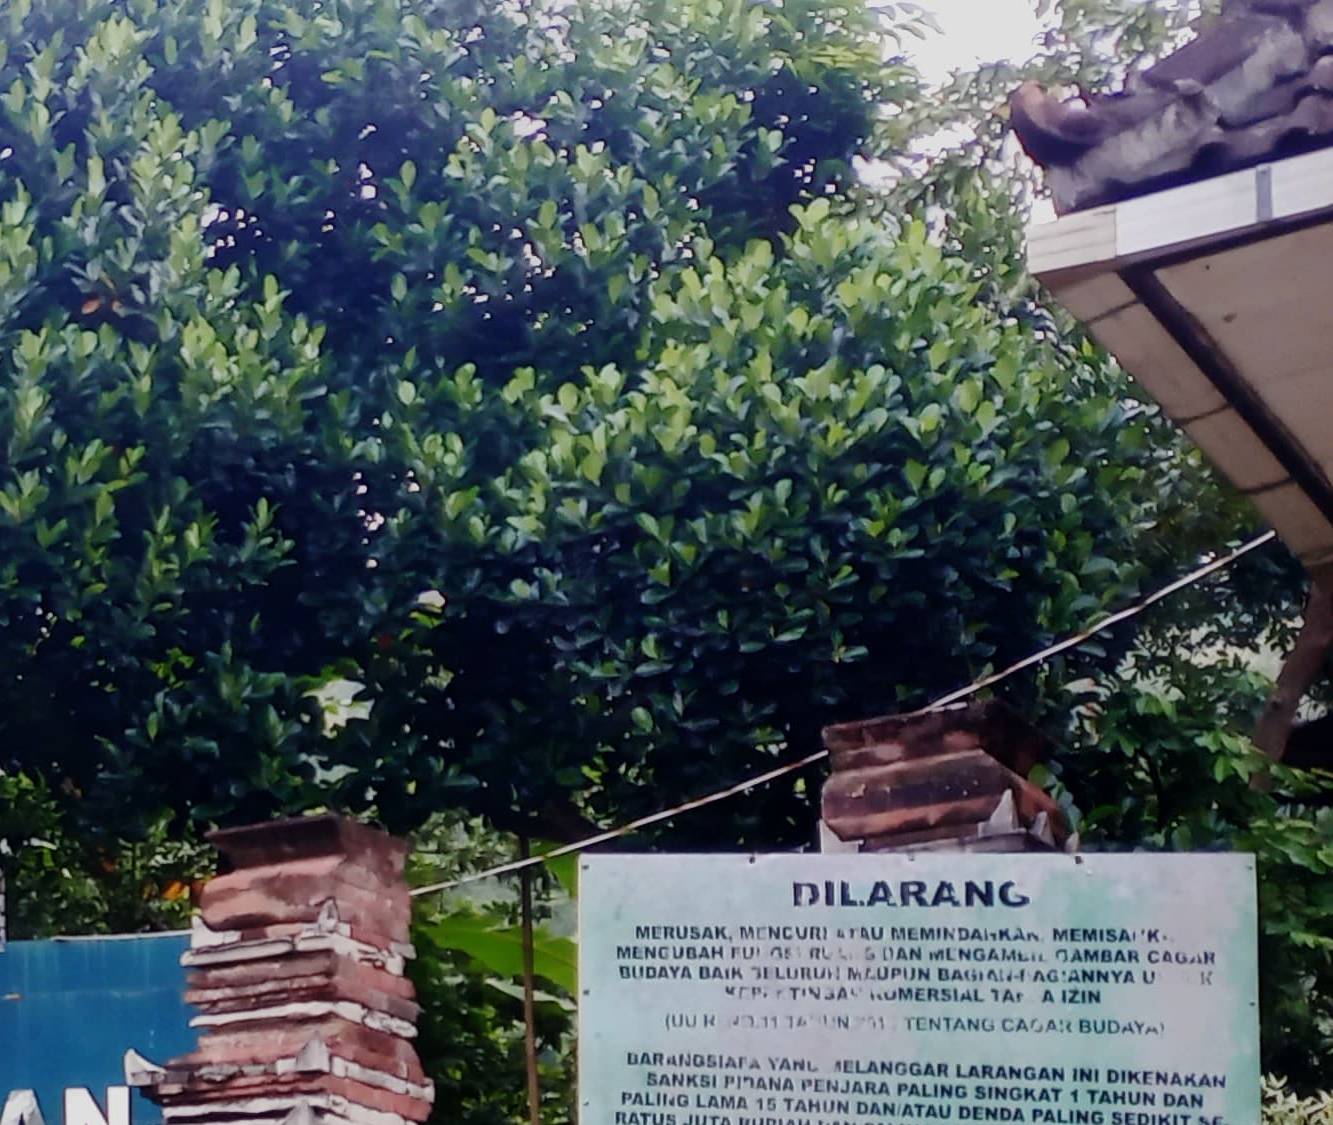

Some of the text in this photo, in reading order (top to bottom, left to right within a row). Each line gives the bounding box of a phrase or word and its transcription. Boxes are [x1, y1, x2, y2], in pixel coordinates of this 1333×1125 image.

[793, 880, 1030, 907] DILARANG
[635, 926, 733, 942] MERUSAK,
[740, 926, 828, 940] MENCURI
[836, 927, 884, 941] ATAU
[616, 946, 724, 960] MENGUBAH
[883, 947, 922, 961] DAN
[1056, 948, 1140, 964] GAMBAR
[1147, 949, 1216, 965] CAGAR
[619, 965, 693, 980] BUDAYA
[698, 966, 743, 980] BAIK
[1061, 989, 1102, 1004] IZIN
[905, 1017, 995, 1033] TENTANG
[956, 1063, 1065, 1082] LARANGAN
[1072, 1068, 1099, 1083] INI
[1107, 1069, 1226, 1088] DIKENAKAN
[646, 1072, 717, 1089] SANKSI
[802, 1078, 891, 1096] PENJARA
[897, 1083, 968, 1099] PALING
[974, 1085, 1063, 1103] SINGKAT
[1070, 1090, 1079, 1103] 1
[1087, 1089, 1156, 1106] TAHUN
[1163, 1093, 1204, 1109] DAN
[621, 1091, 689, 1108] PALING
[696, 1094, 748, 1110] LAMA
[756, 1098, 777, 1111] 15
[783, 1098, 850, 1114] TAHUN
[856, 1101, 952, 1119] DAN/ATAU
[958, 1105, 1025, 1123] DENDA
[1032, 1109, 1104, 1125] PALING
